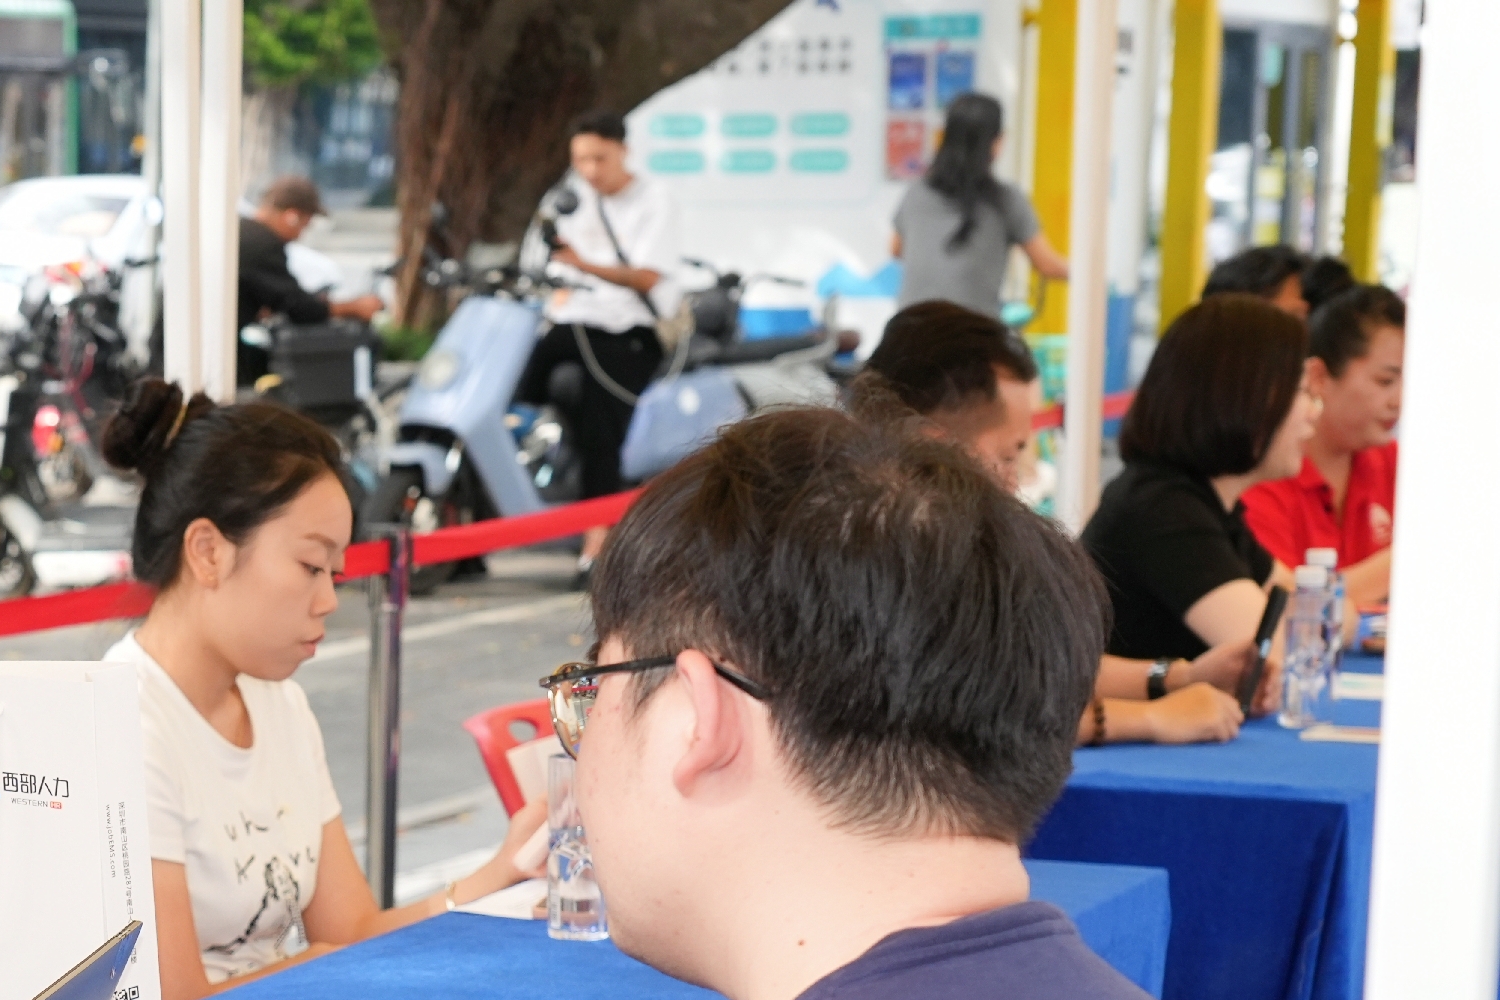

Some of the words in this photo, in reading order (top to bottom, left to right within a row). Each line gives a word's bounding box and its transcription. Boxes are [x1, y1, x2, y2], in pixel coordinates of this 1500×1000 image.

[2, 771, 70, 798] 西部人力
[11, 797, 49, 808] WESTERN
[105, 804, 116, 878] www.jobEMS.com
